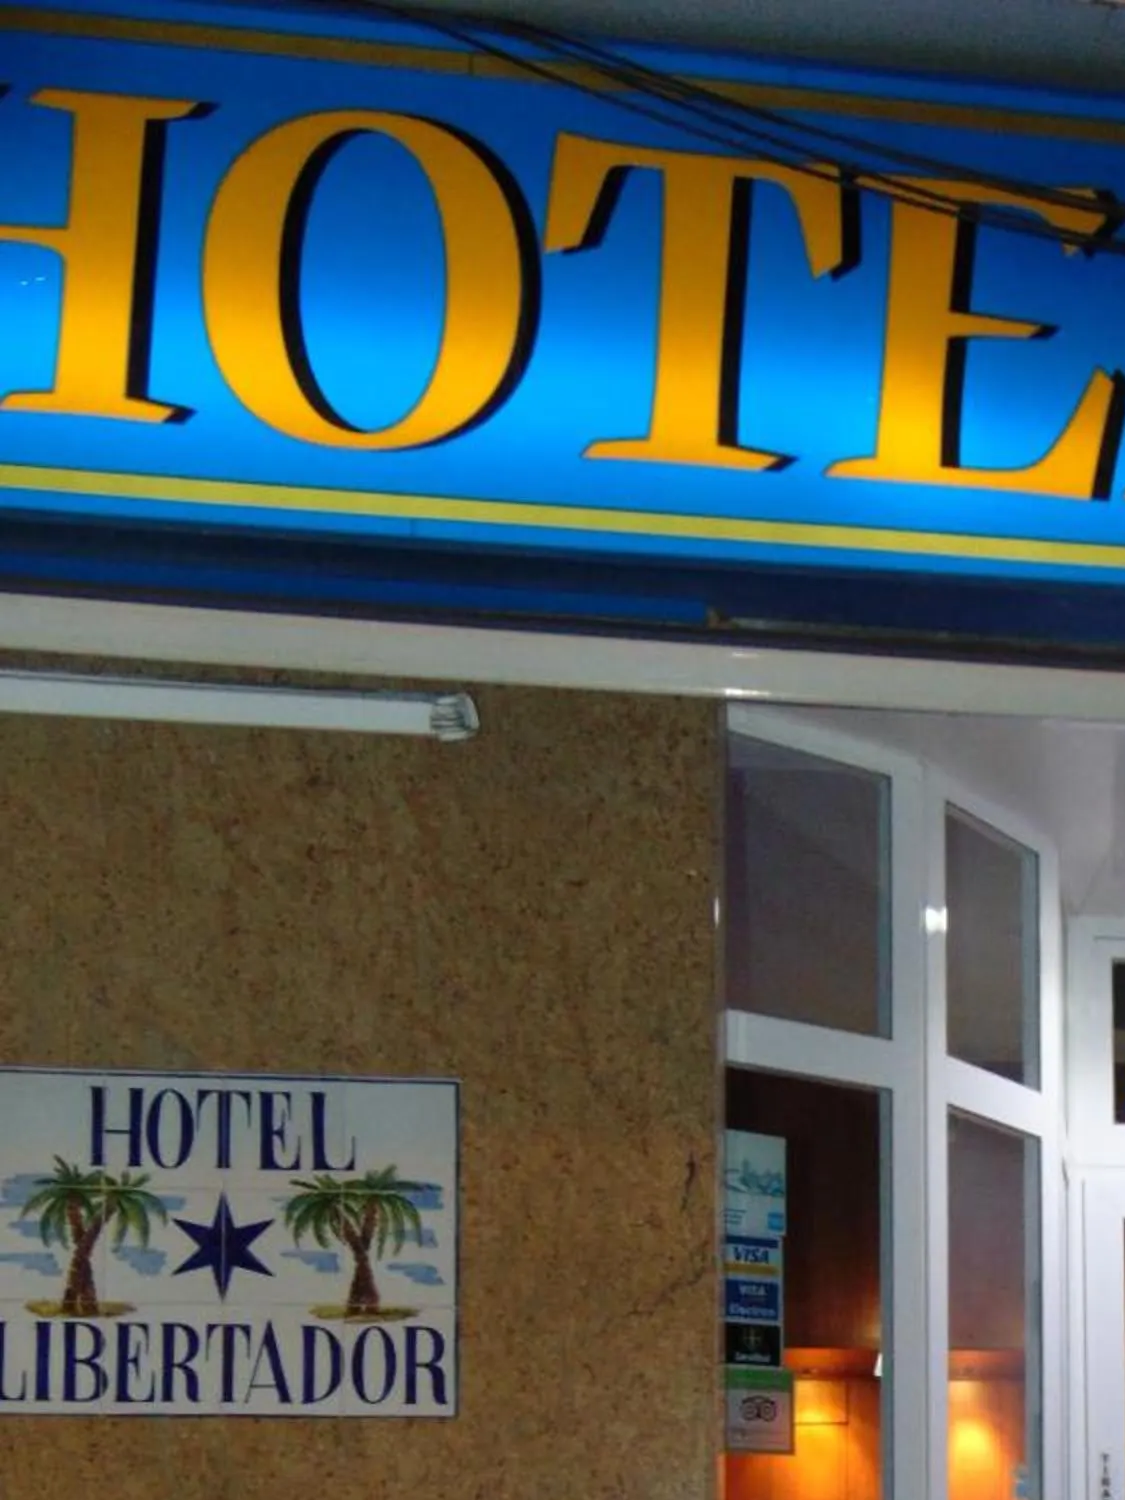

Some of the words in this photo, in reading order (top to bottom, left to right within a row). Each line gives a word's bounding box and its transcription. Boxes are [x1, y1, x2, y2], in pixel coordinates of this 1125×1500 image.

[89, 1086, 357, 1171] HOTEL
[732, 1246, 769, 1264] VISA
[0, 1319, 448, 1405] LIBERTADOR
